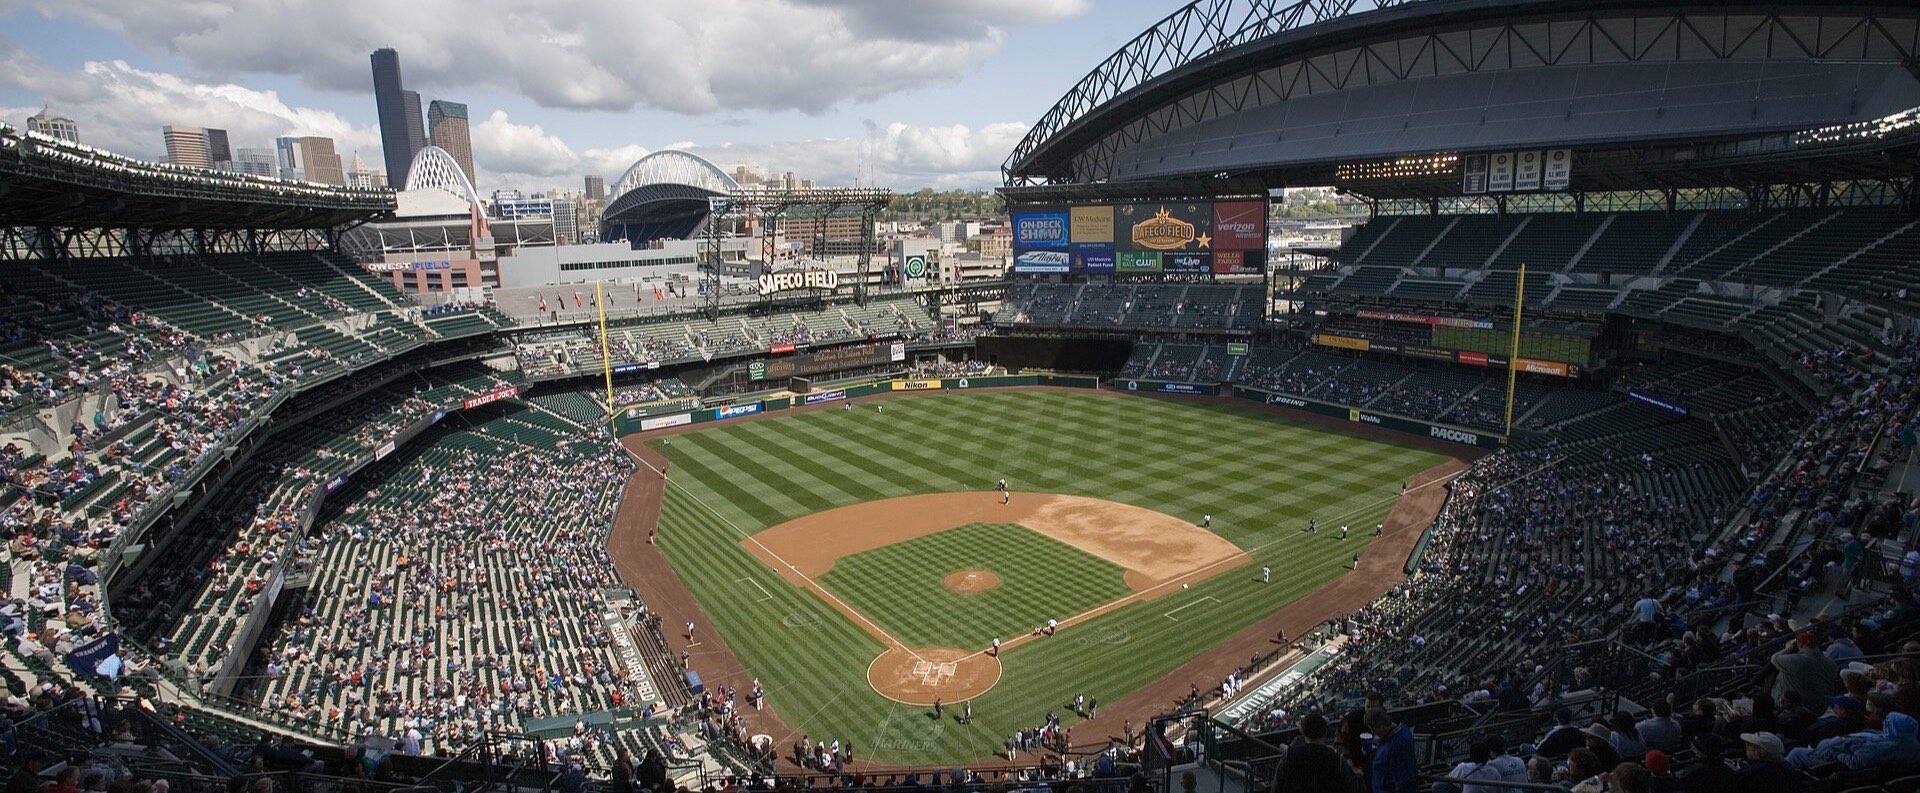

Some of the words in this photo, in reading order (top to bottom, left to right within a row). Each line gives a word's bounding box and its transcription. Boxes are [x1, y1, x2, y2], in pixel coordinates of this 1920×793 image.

[1134, 226, 1166, 240] SAFECO
[1167, 225, 1192, 238] FIELD
[1218, 222, 1254, 232] verizon
[412, 261, 452, 270] FIELD
[759, 272, 804, 295] SAFECO
[805, 270, 838, 288] FIELD
[1526, 364, 1560, 374] Microsoft
[469, 394, 495, 408] TRADER
[1276, 396, 1305, 406] BOEING
[730, 404, 757, 414] PEPSI
[1361, 414, 1380, 424] WaMu
[1431, 426, 1476, 445] PACCAR
[621, 647, 635, 658] TO
[625, 658, 646, 681] SAFECO
[637, 681, 656, 700] FIELD
